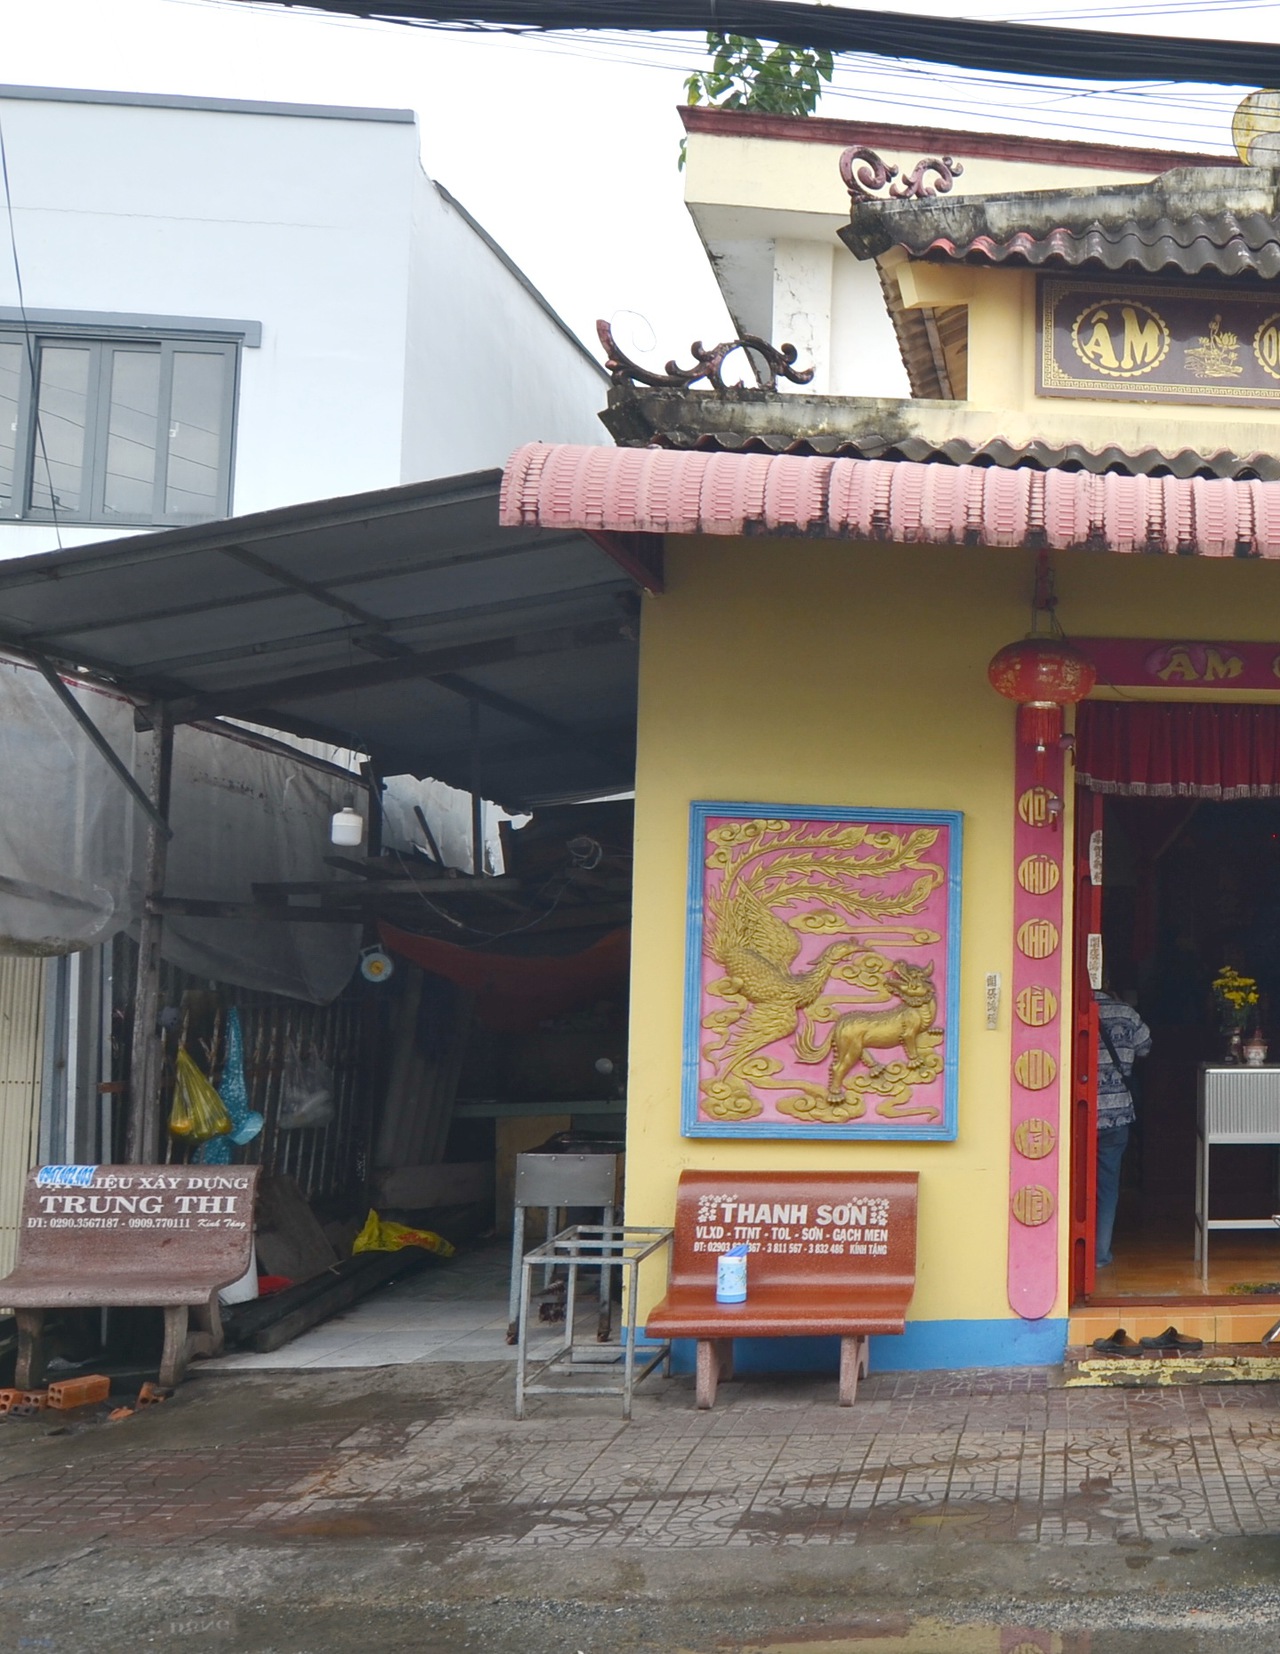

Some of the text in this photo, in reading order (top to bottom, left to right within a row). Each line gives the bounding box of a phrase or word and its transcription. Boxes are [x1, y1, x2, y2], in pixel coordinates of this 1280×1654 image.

[1086, 307, 1162, 369] ÂM
[1157, 645, 1244, 681] ÂM
[1014, 1050, 1056, 1090] NON
[138, 1174, 180, 1189] XÂY
[187, 1175, 248, 1191] DỰNG
[40, 1196, 238, 1214] TRUNG THI
[721, 1203, 867, 1226] THANH SƠN
[695, 1226, 724, 1240] VLXD
[734, 1227, 761, 1240] TTNT
[771, 1227, 791, 1241] TOL
[802, 1227, 823, 1241] SƠN
[833, 1228, 861, 1244] GẠCH
[864, 1229, 888, 1242] MEN
